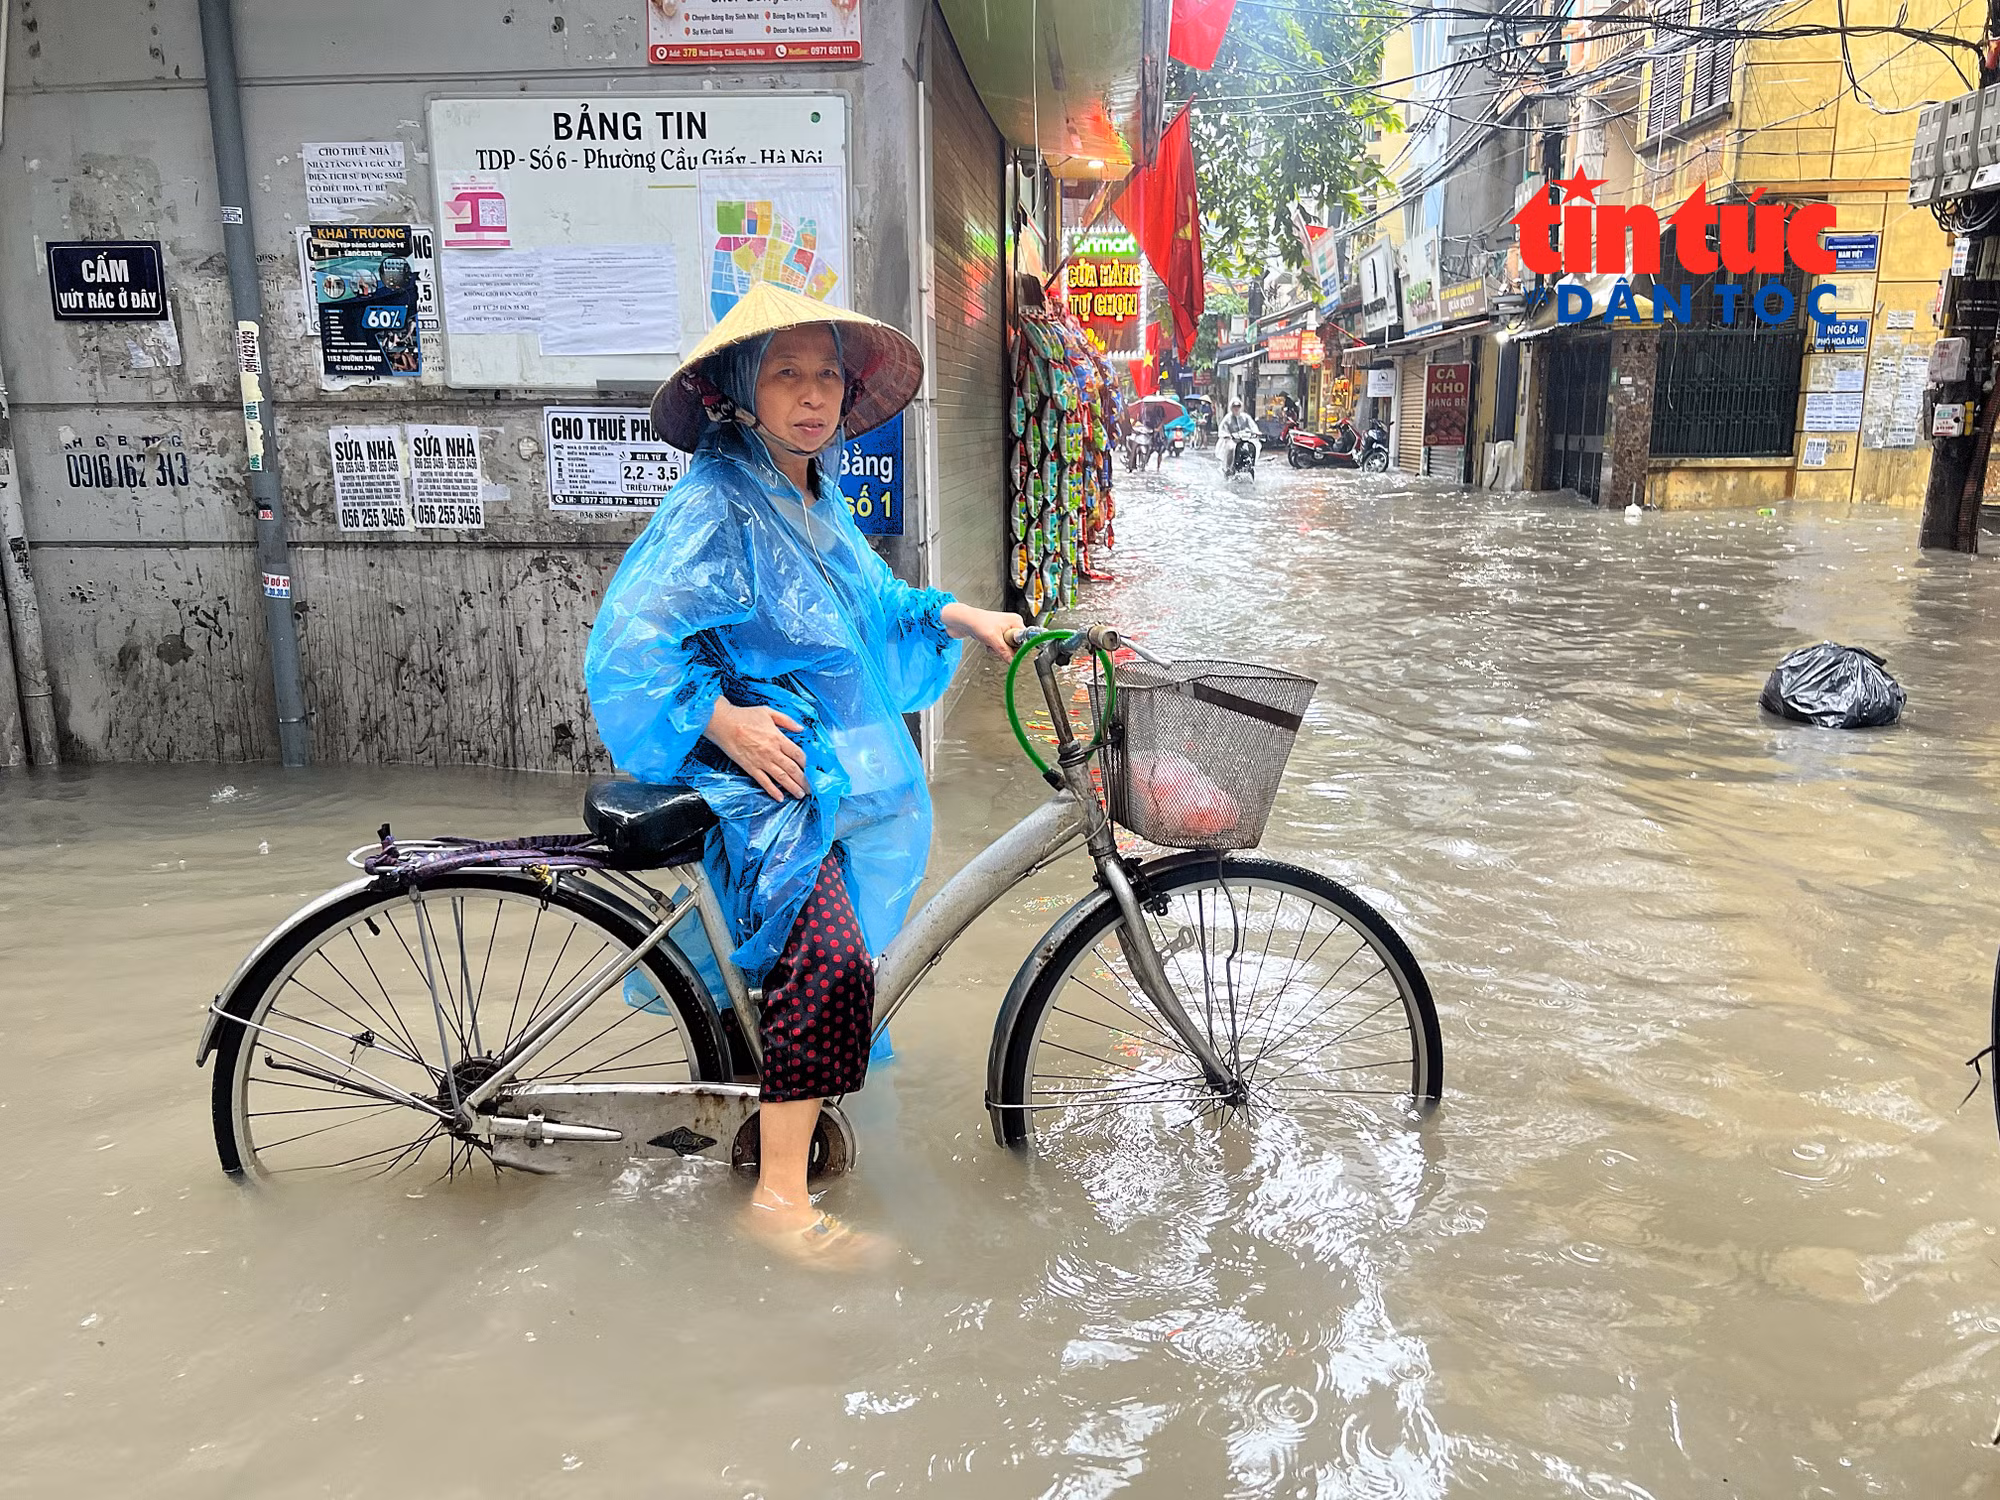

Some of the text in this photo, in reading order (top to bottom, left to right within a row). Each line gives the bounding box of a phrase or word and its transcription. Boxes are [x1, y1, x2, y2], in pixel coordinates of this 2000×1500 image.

[725, 13, 735, 21] Bay
[810, 46, 827, 55] 0971
[828, 46, 841, 55] 601
[843, 46, 853, 54] 111
[553, 103, 707, 141] BẢNG TIN
[318, 145, 390, 157] CHO THUÊ NHÀ
[476, 149, 516, 170] TDP
[529, 144, 553, 170] Số
[556, 151, 567, 170] 6
[583, 148, 656, 173] Phường
[661, 146, 698, 171] Cầu
[317, 228, 348, 239] KHAI
[1838, 251, 1851, 259] NAM
[81, 251, 130, 283] CẤM
[1067, 258, 1142, 288] CỬA HÀNG
[59, 287, 157, 309] VỨT RÁC Ở ĐÂY
[1069, 292, 1138, 322] TỰ CHỌN
[368, 310, 401, 328] 60%
[1827, 322, 1859, 335] NGÕ 54
[1832, 337, 1846, 345] HOA
[1431, 382, 1465, 394] KHO
[552, 417, 584, 440] CHO
[587, 415, 627, 441] THUÊ
[334, 432, 397, 461] SỬA NHÀ
[414, 429, 476, 458] SỬA NHÀ
[65, 454, 113, 488] 0916
[840, 443, 893, 483] Bằng
[624, 466, 645, 482] 2,2
[658, 466, 678, 482] 3,5
[418, 505, 481, 524] 056 255 3456
[881, 491, 891, 518] 1
[342, 508, 406, 528] 056 255 3456
